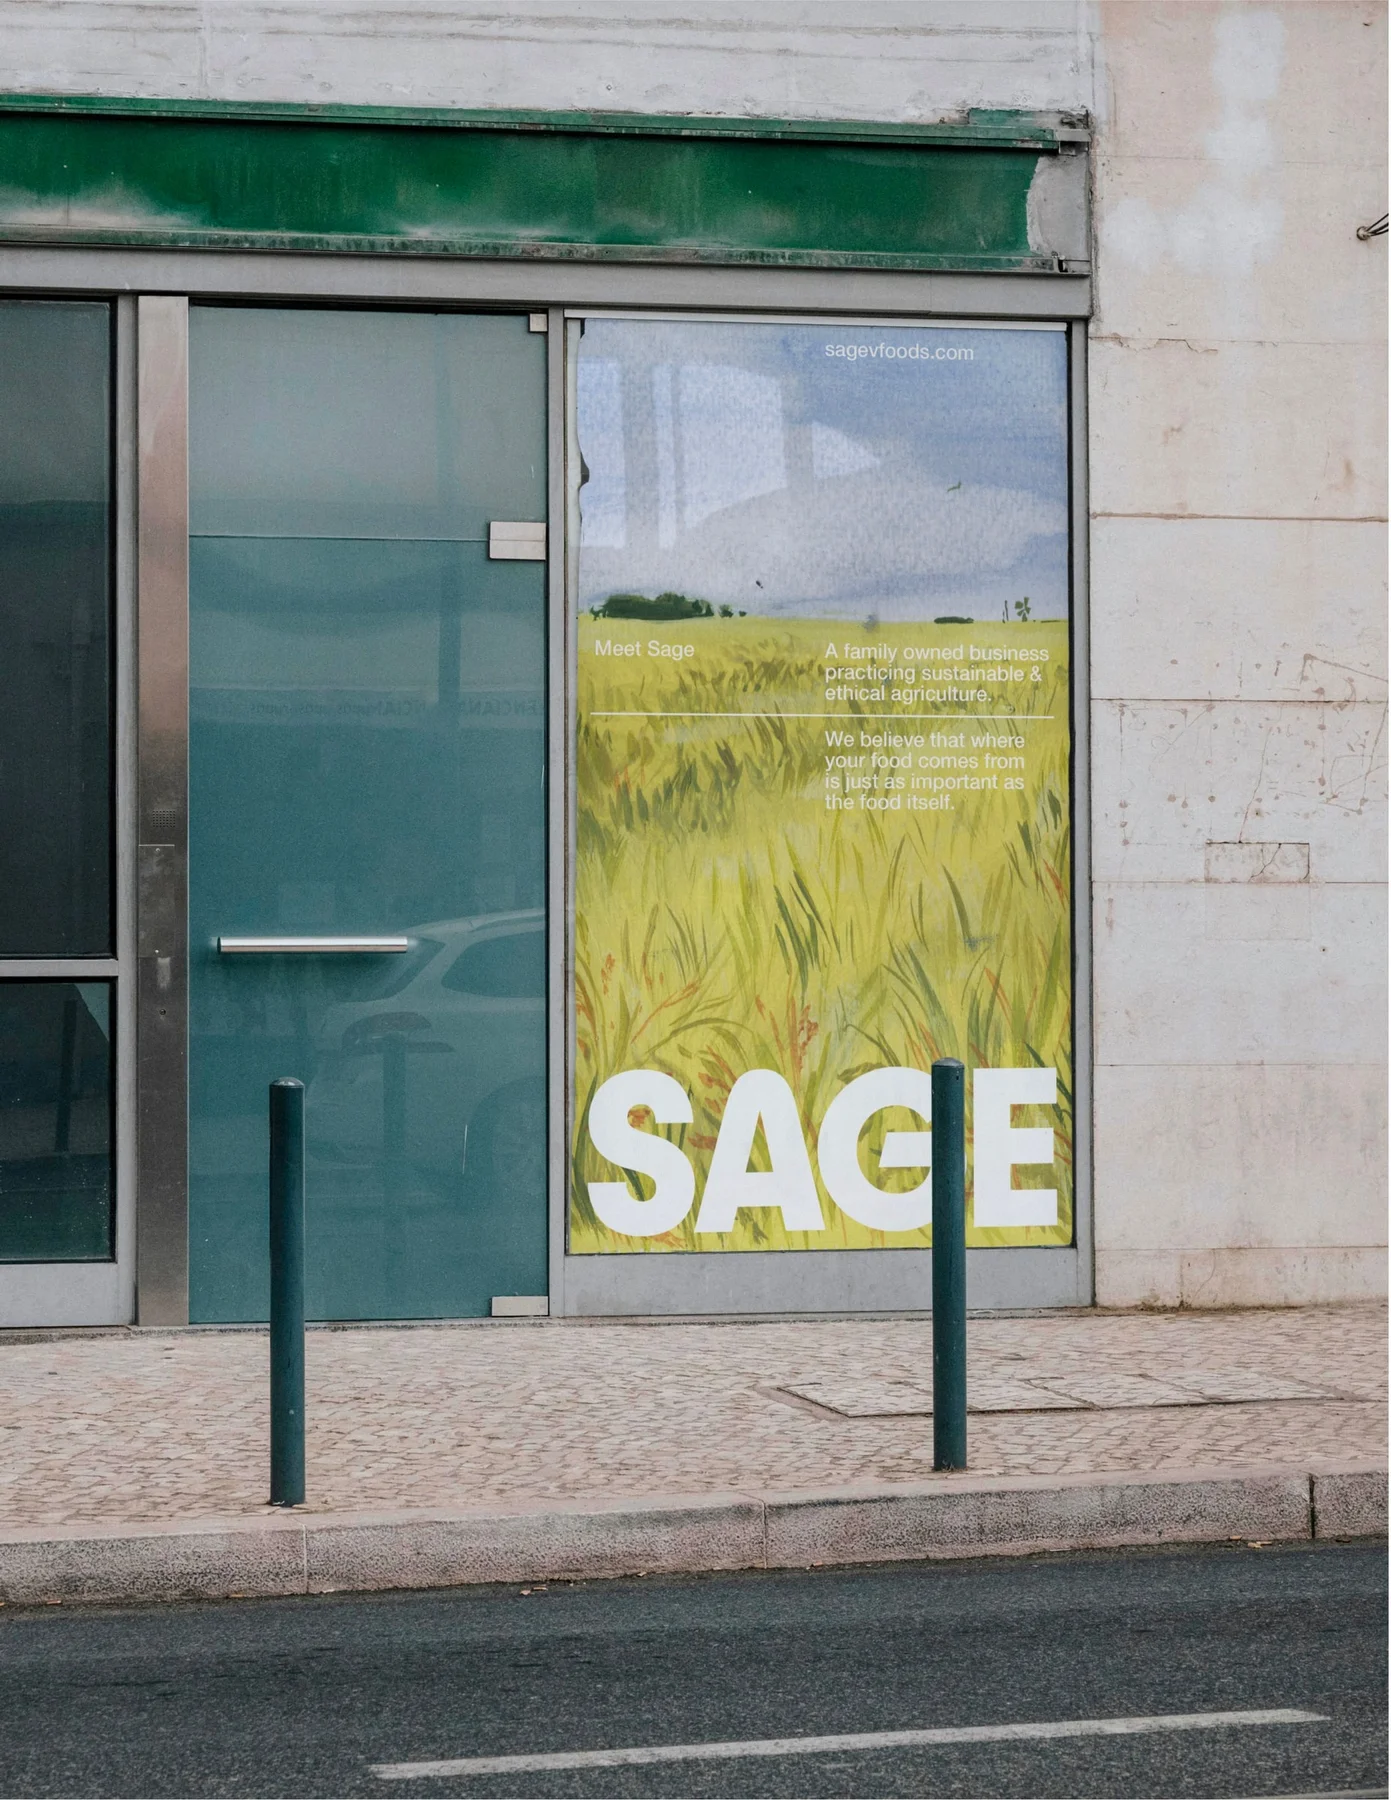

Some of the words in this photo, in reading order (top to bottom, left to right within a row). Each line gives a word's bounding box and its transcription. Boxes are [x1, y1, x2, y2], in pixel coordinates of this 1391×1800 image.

[825, 343, 974, 361] sagevfoods.com
[595, 640, 641, 657] Meet
[647, 640, 695, 661] Sage
[824, 643, 839, 660] A
[843, 643, 897, 663] family
[903, 645, 963, 661] owned
[969, 645, 1049, 662] business
[825, 665, 916, 684] practicing
[921, 666, 1024, 682] sustainable
[1029, 666, 1042, 682] &
[824, 685, 885, 701] ethical
[890, 686, 992, 705] agriculture.
[825, 731, 855, 748] We
[860, 732, 925, 748] believe
[930, 732, 965, 748] that
[970, 732, 1025, 749] where
[824, 756, 866, 771] your
[870, 752, 912, 769] food
[918, 756, 979, 769] comes
[984, 753, 1025, 769] from
[825, 774, 840, 789] is
[845, 774, 879, 792] just
[884, 777, 905, 789] as
[911, 774, 998, 792] important
[1003, 777, 1025, 790] as
[825, 794, 855, 810] the
[858, 794, 901, 810] food
[907, 794, 955, 810] itself.
[587, 1066, 1058, 1237] SAGE
